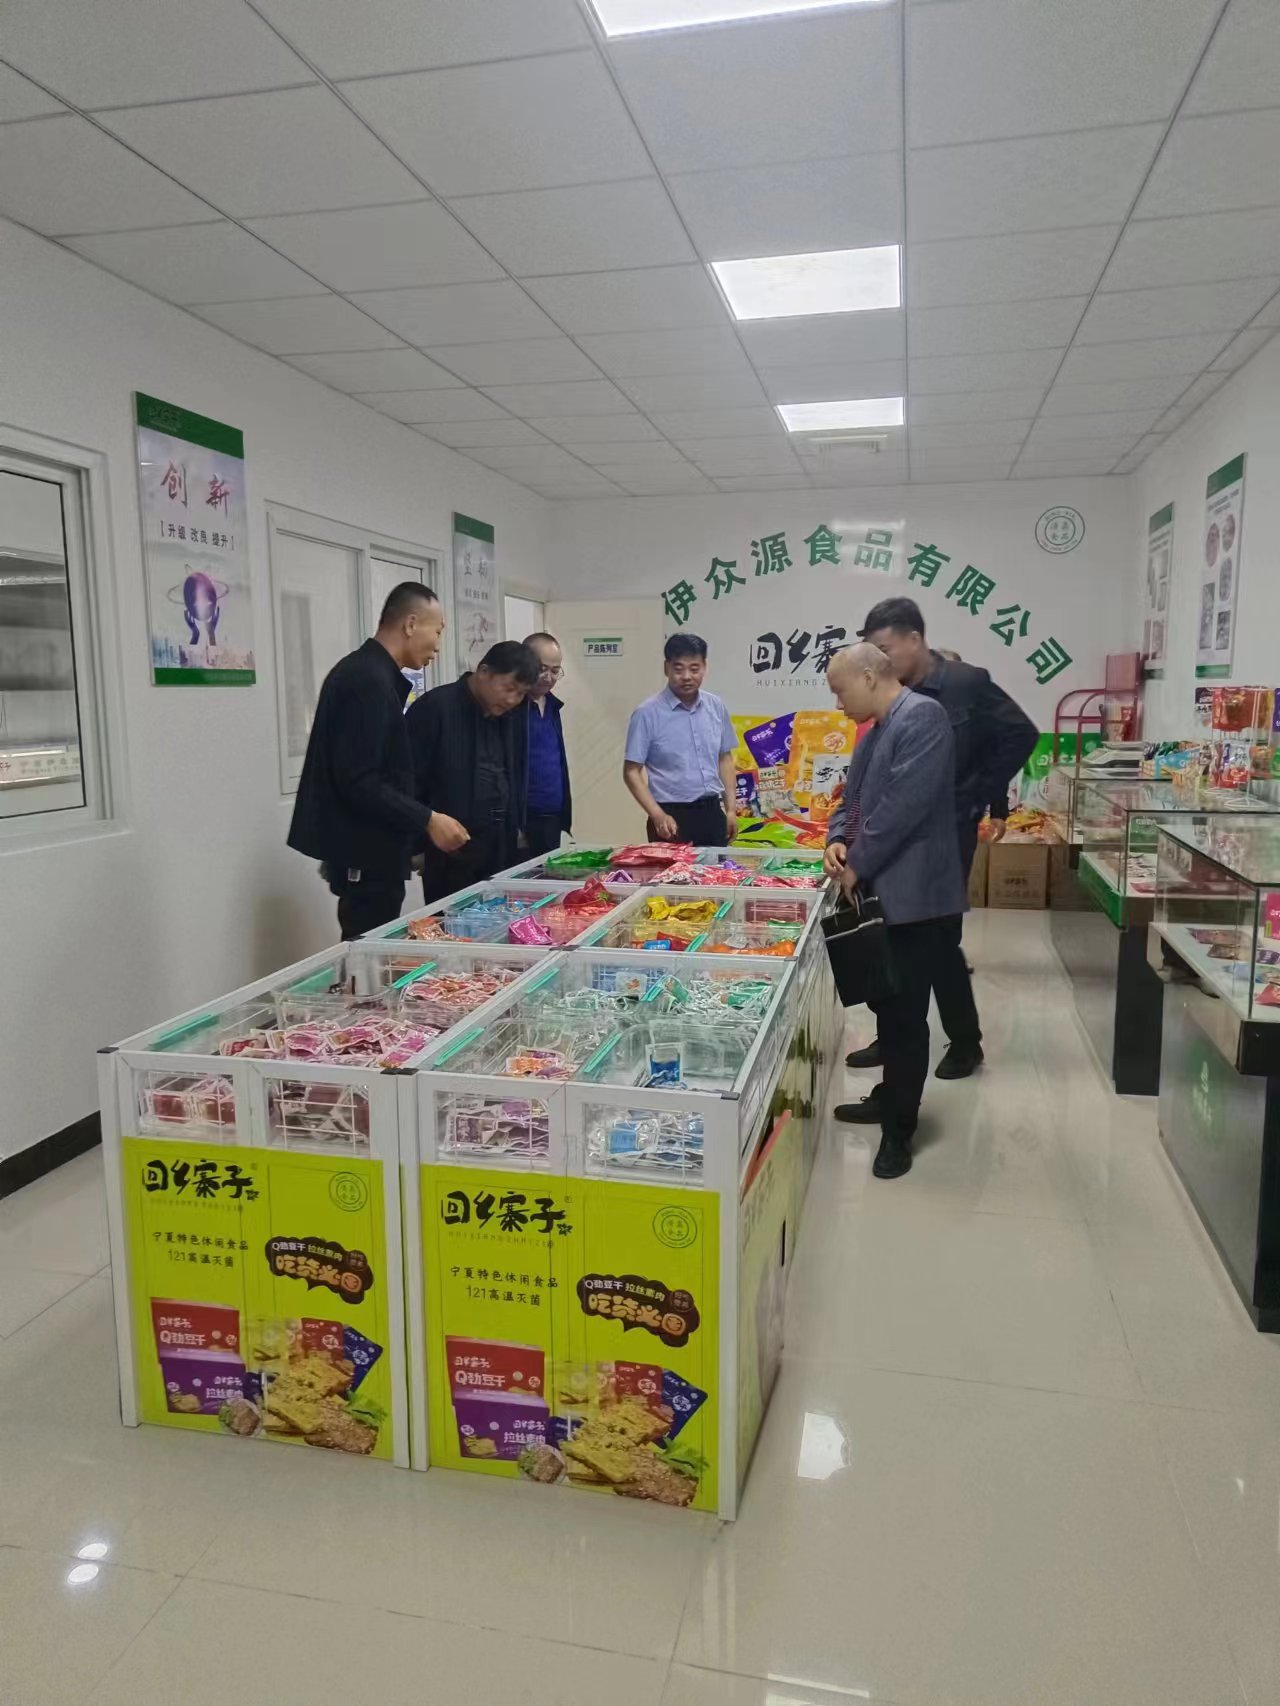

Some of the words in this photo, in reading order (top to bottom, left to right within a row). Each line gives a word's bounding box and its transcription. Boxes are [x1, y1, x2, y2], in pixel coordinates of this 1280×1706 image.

[160, 461, 230, 516] 创新
[660, 523, 1073, 685] 伊众源食品有限公司
[749, 625, 865, 674] 回乡寨
[141, 1158, 254, 1199] 回乡寨子
[440, 1190, 566, 1234] 回乡寨子
[152, 1231, 249, 1250] 宁夏特色休闲食品
[167, 1249, 234, 1268] 121高温灭菌
[450, 1265, 558, 1288] 宁夏特色休闲食品
[465, 1284, 540, 1307] 121高温灭菌
[455, 1370, 506, 1387] Q劲豆干
